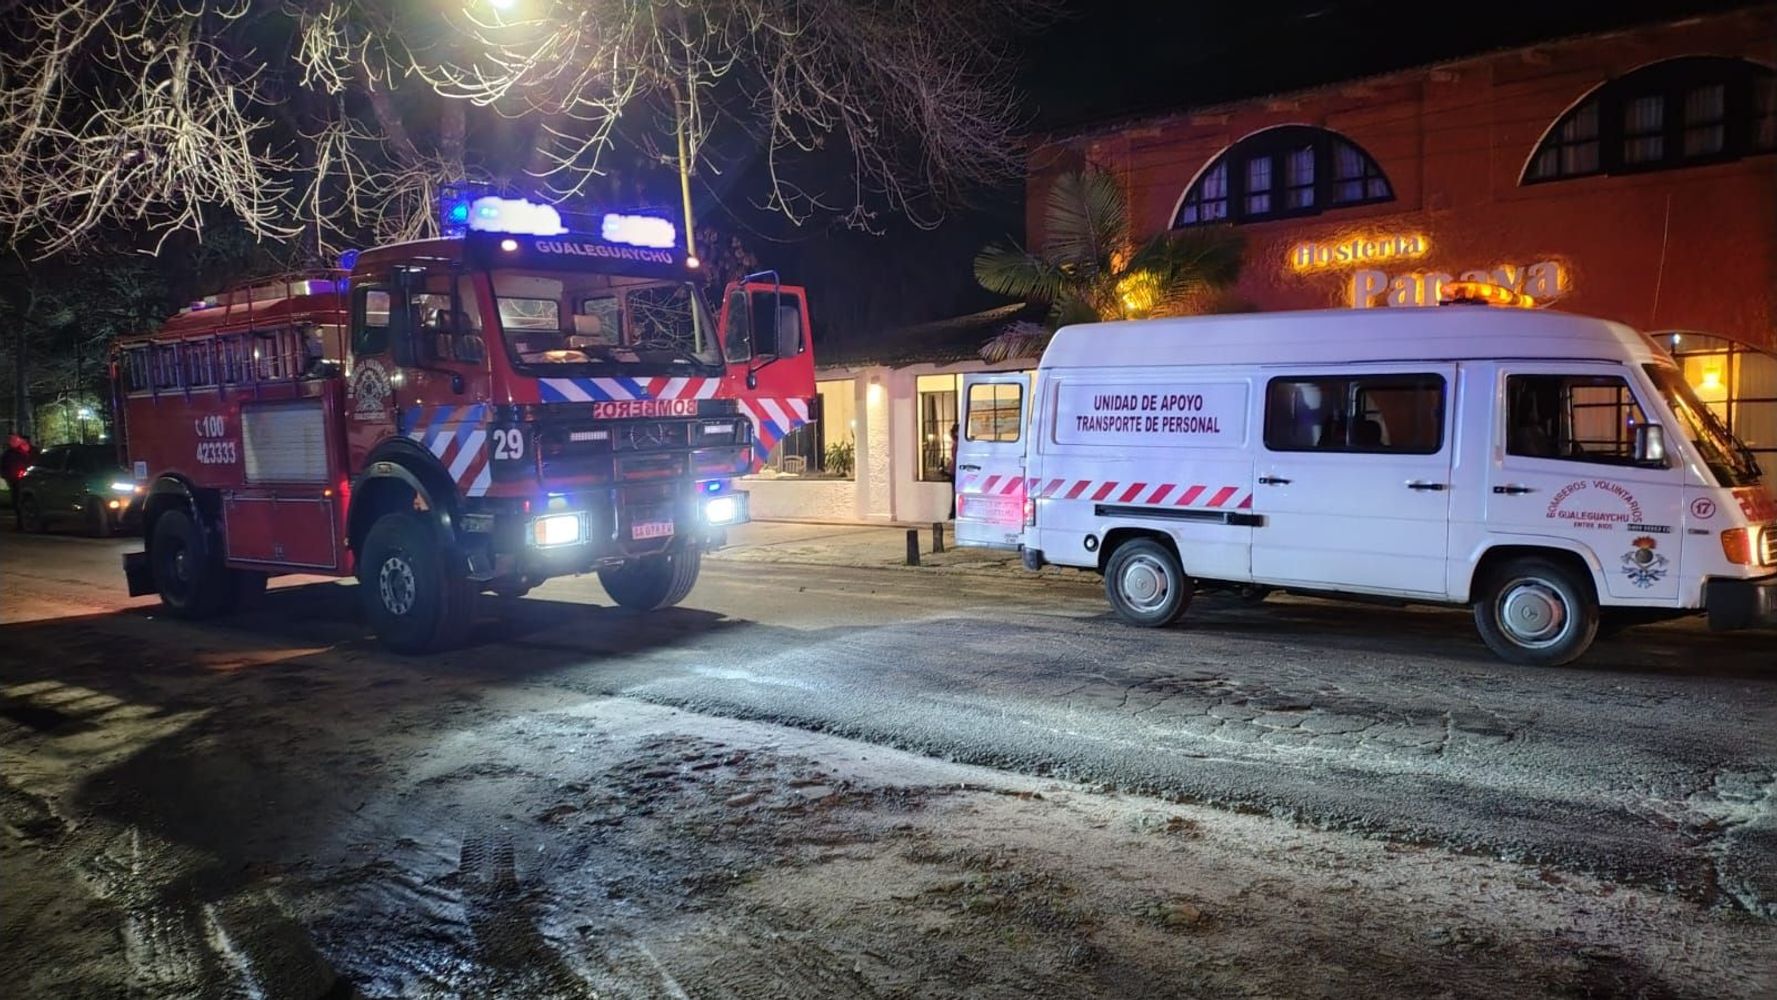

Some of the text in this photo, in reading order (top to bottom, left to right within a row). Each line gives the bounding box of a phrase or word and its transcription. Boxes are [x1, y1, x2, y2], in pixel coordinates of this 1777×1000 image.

[1094, 394, 1203, 411] UNIDAD DE APOYO
[203, 415, 224, 437] 100
[1076, 415, 1220, 433] TRANSPORTE DE PERSONAL
[196, 442, 236, 464] 423333
[493, 429, 524, 460] 29
[1546, 480, 1642, 523] BOMBEROS VOLUNTARIOS
[1696, 503, 1711, 514] 17
